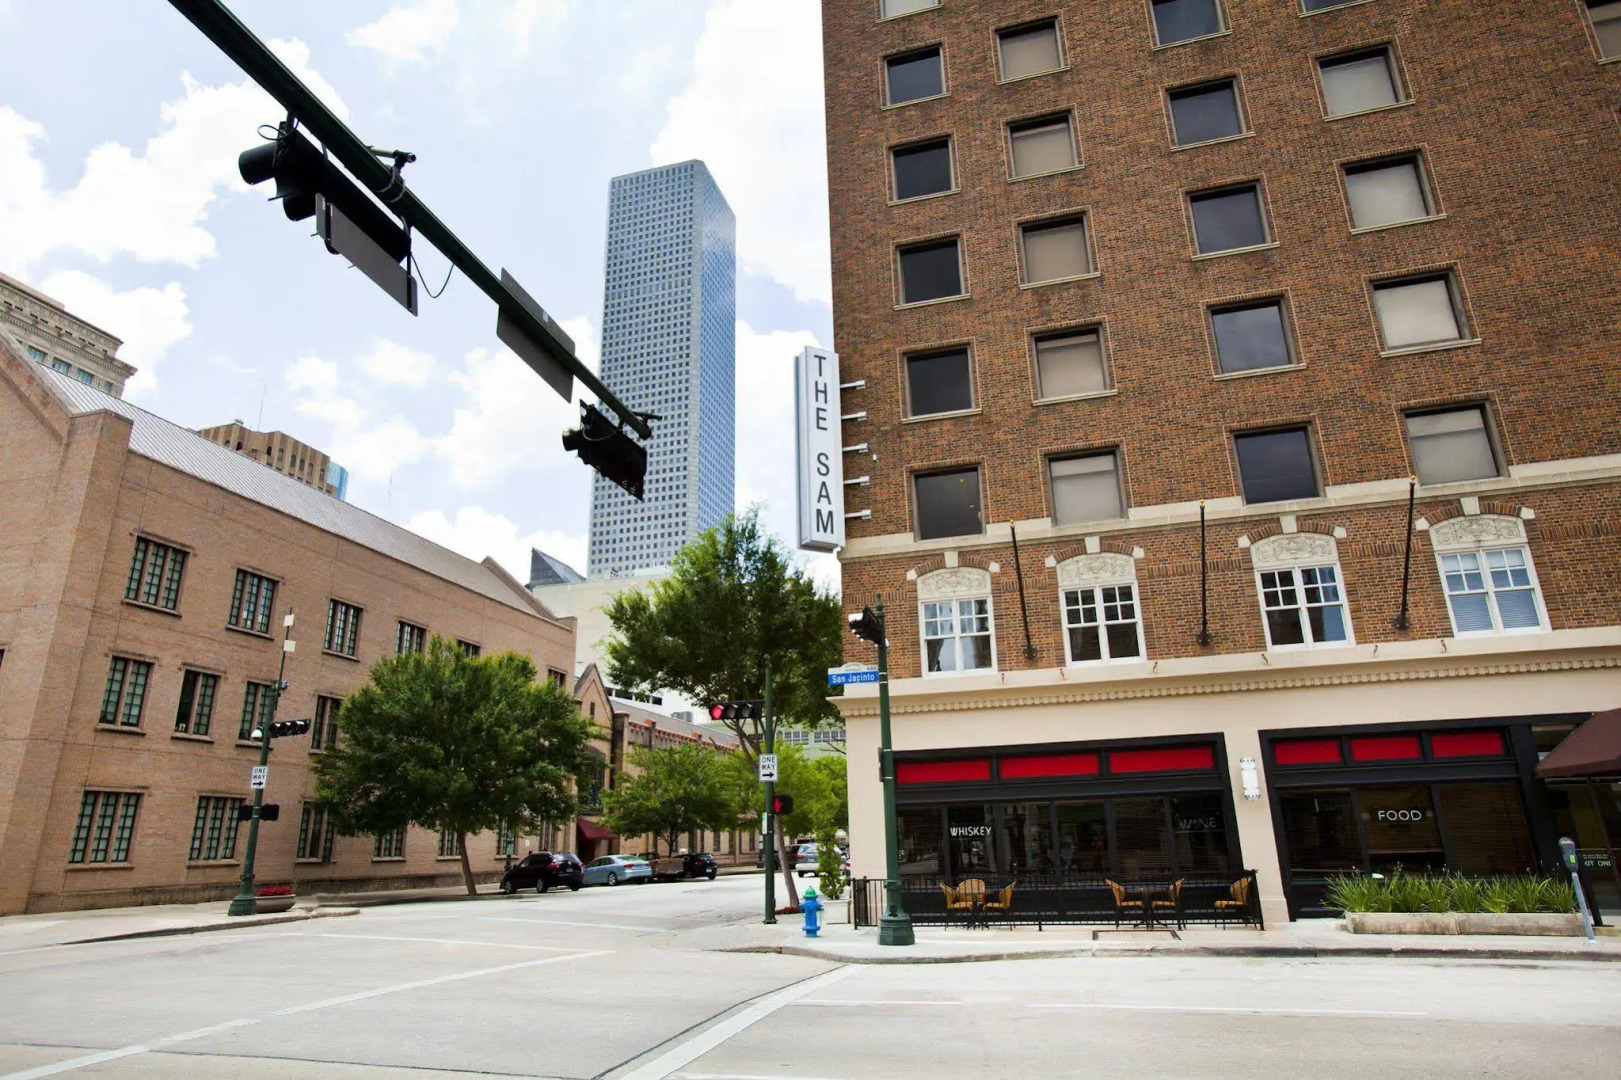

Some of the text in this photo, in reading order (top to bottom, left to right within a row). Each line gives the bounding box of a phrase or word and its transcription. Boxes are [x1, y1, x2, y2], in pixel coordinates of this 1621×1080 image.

[814, 355, 834, 534] THE SAM
[832, 673, 875, 683] San Jacinto
[761, 763, 776, 771] WAY
[1378, 809, 1422, 821] FOOD
[1179, 817, 1217, 829] WINE
[949, 826, 992, 837] WHISKEY
